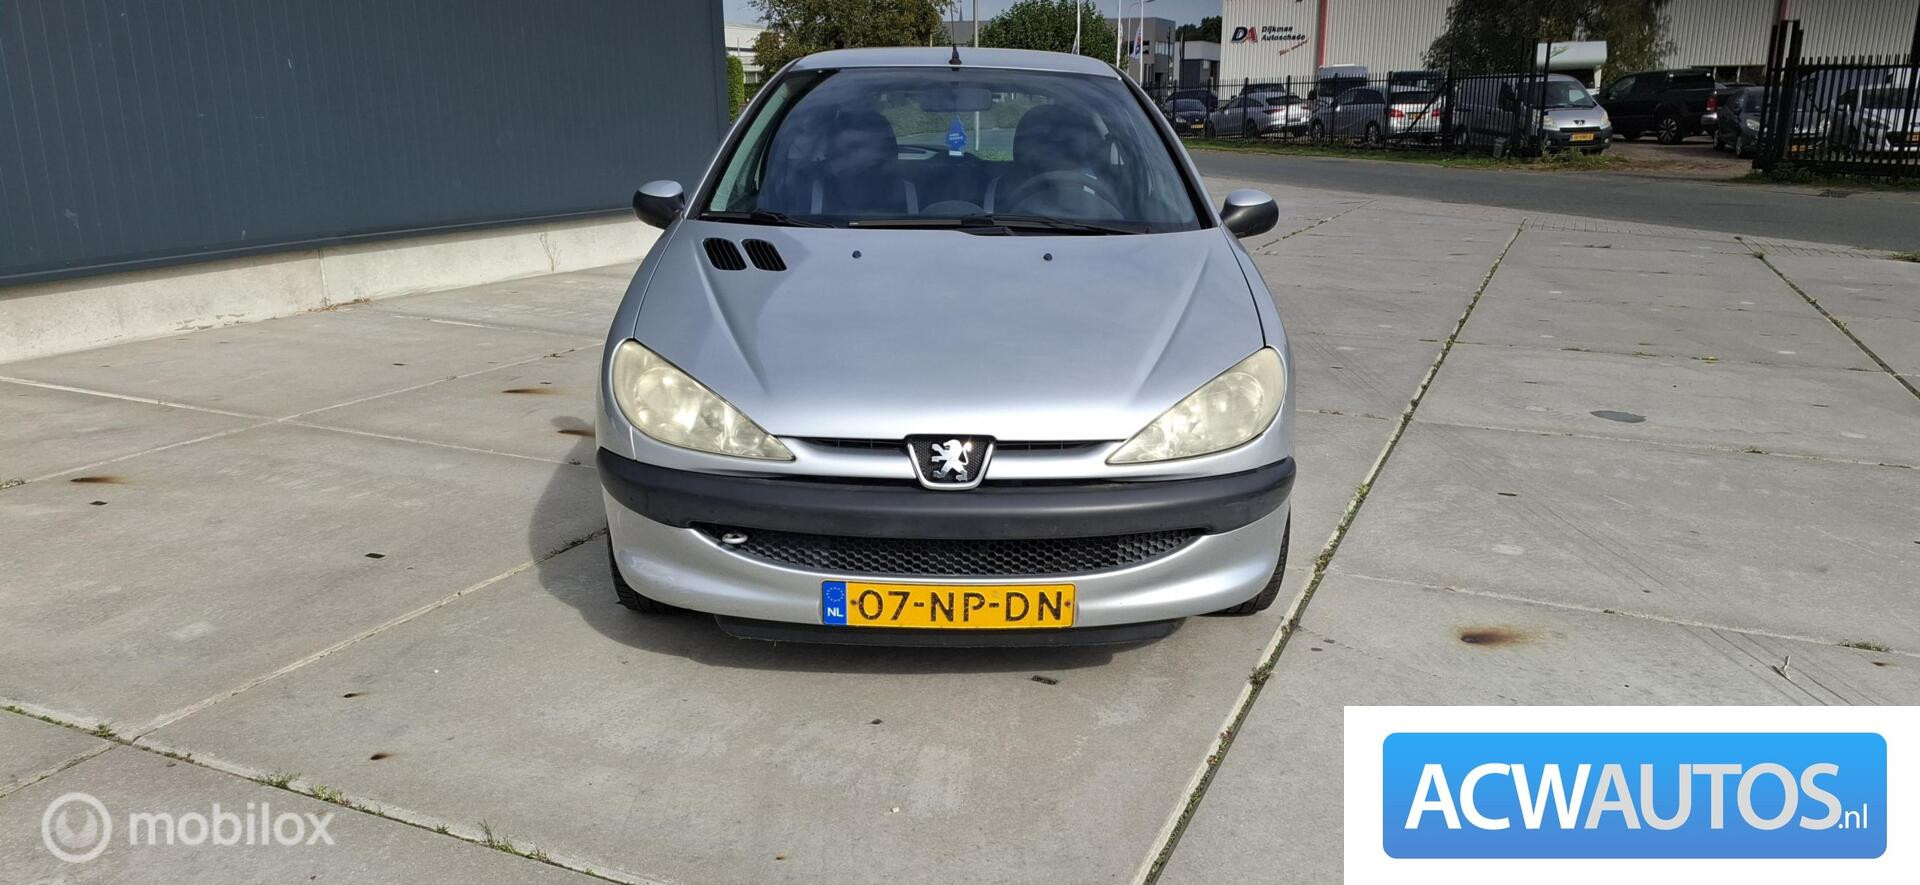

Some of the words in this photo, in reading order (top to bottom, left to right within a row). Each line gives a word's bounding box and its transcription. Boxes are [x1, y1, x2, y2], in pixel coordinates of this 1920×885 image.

[1261, 26, 1293, 34] Dijkman
[857, 589, 1062, 622] 07-NP-DN
[827, 607, 844, 618] NL
